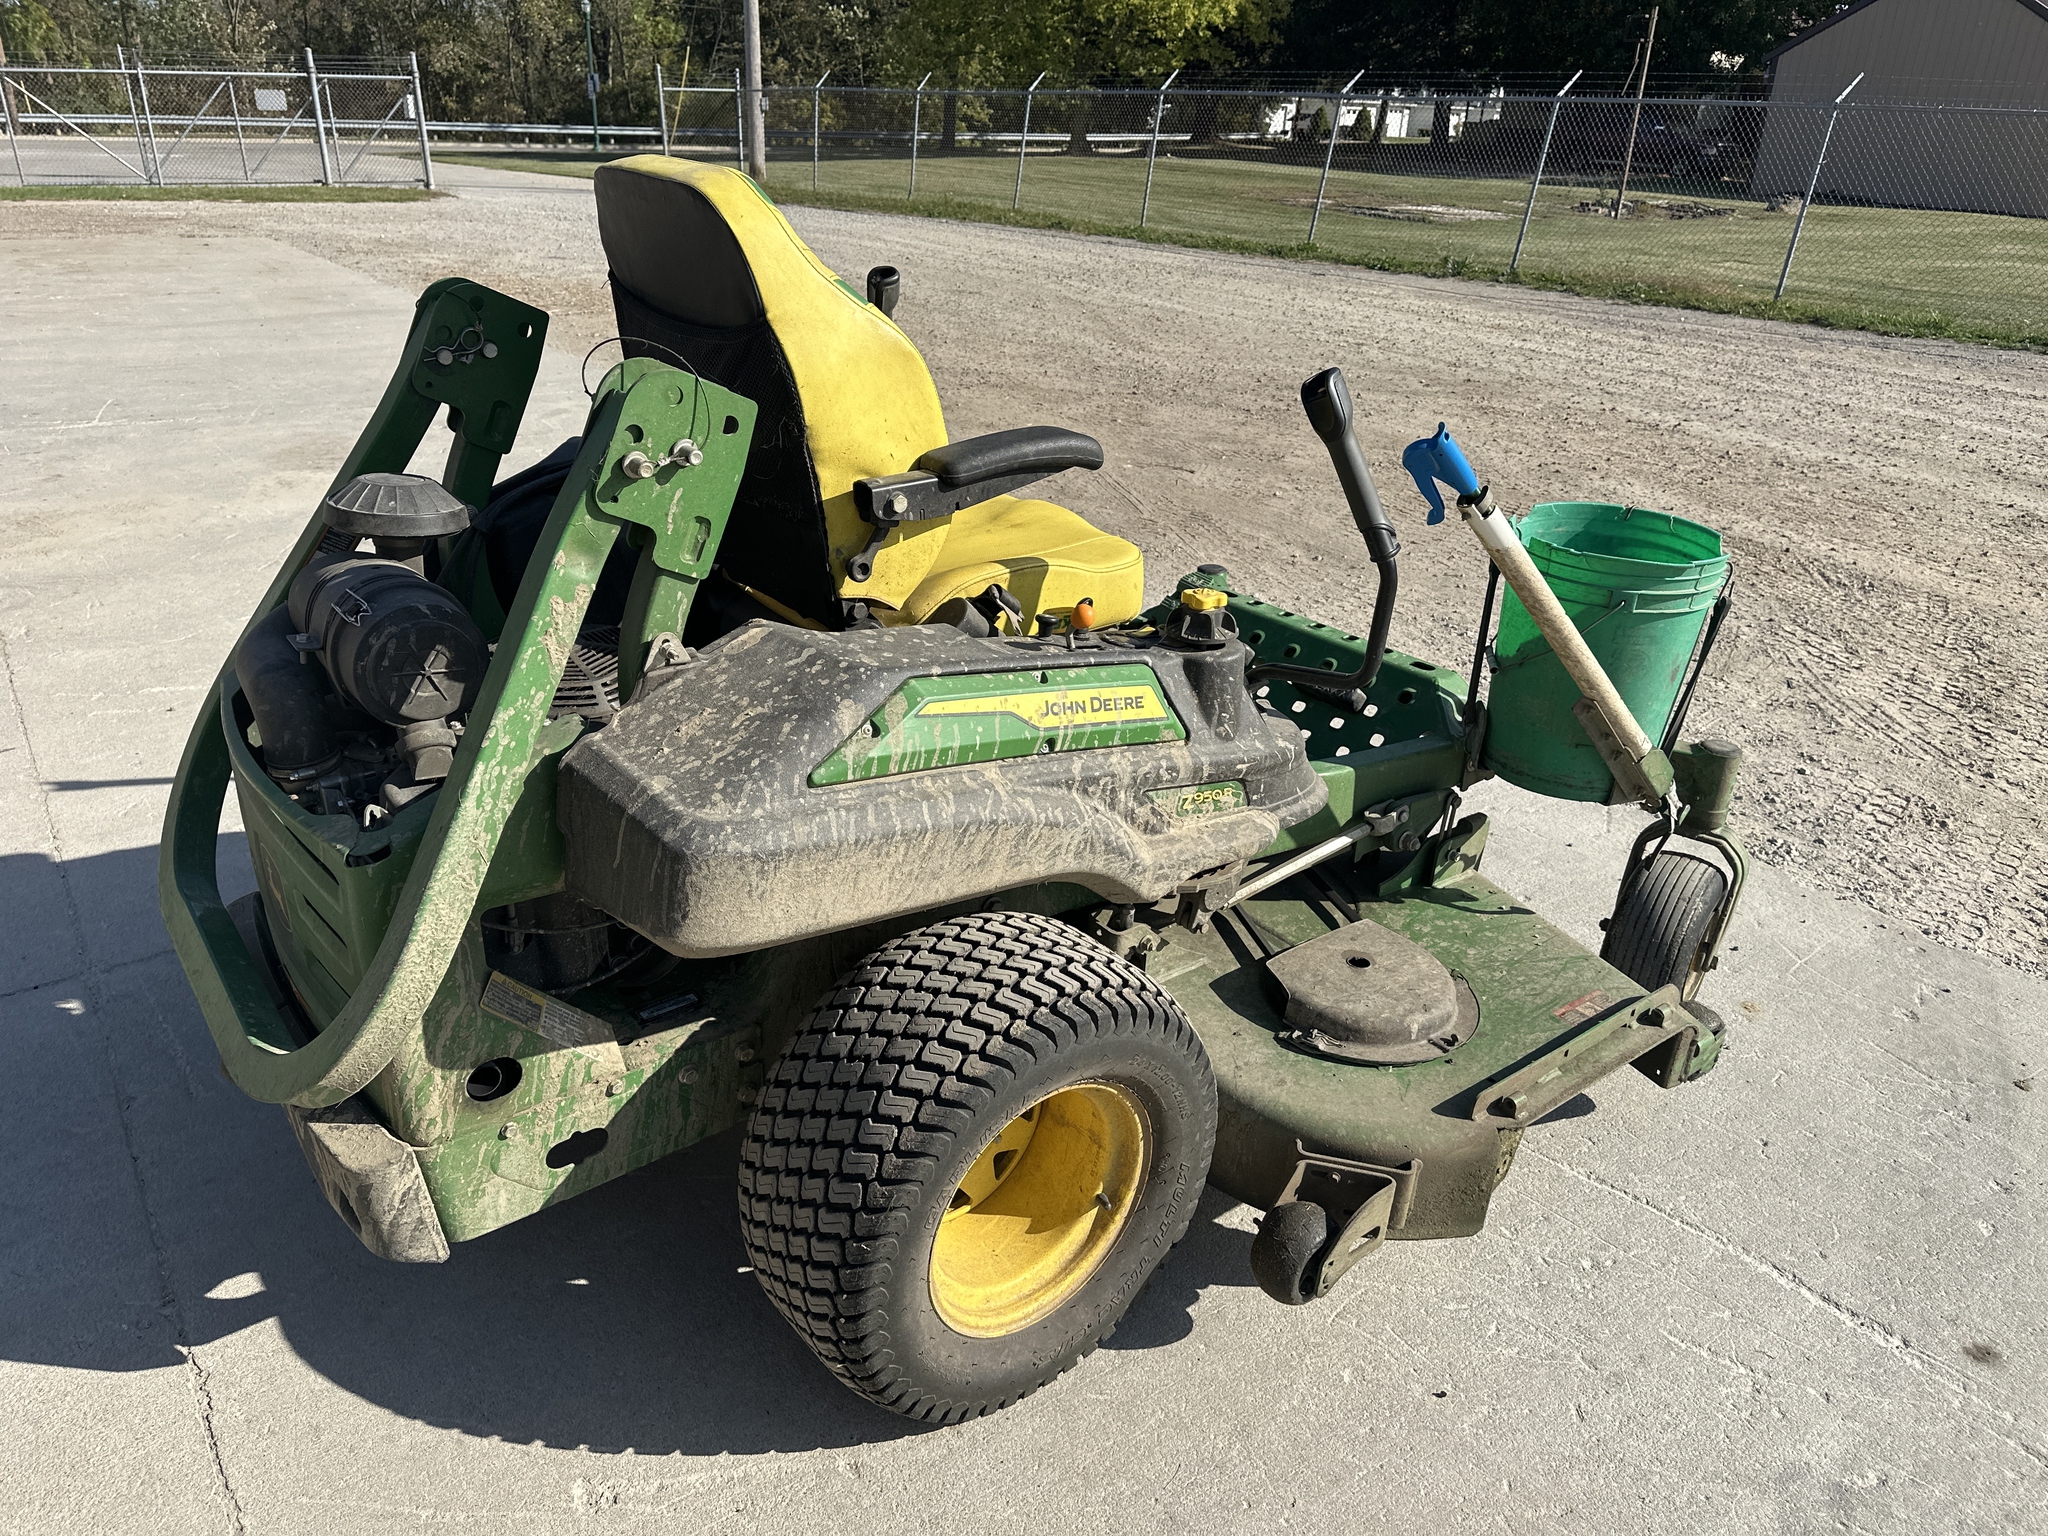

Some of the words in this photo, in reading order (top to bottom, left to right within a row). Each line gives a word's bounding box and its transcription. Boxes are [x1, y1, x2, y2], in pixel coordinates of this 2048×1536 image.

[1041, 700, 1086, 718] JOHN
[1090, 696, 1145, 713] DEERE
[507, 982, 533, 1000] CAUTION
[1153, 1162, 1190, 1248] MULTI
[1098, 1256, 1152, 1324] TRAC
